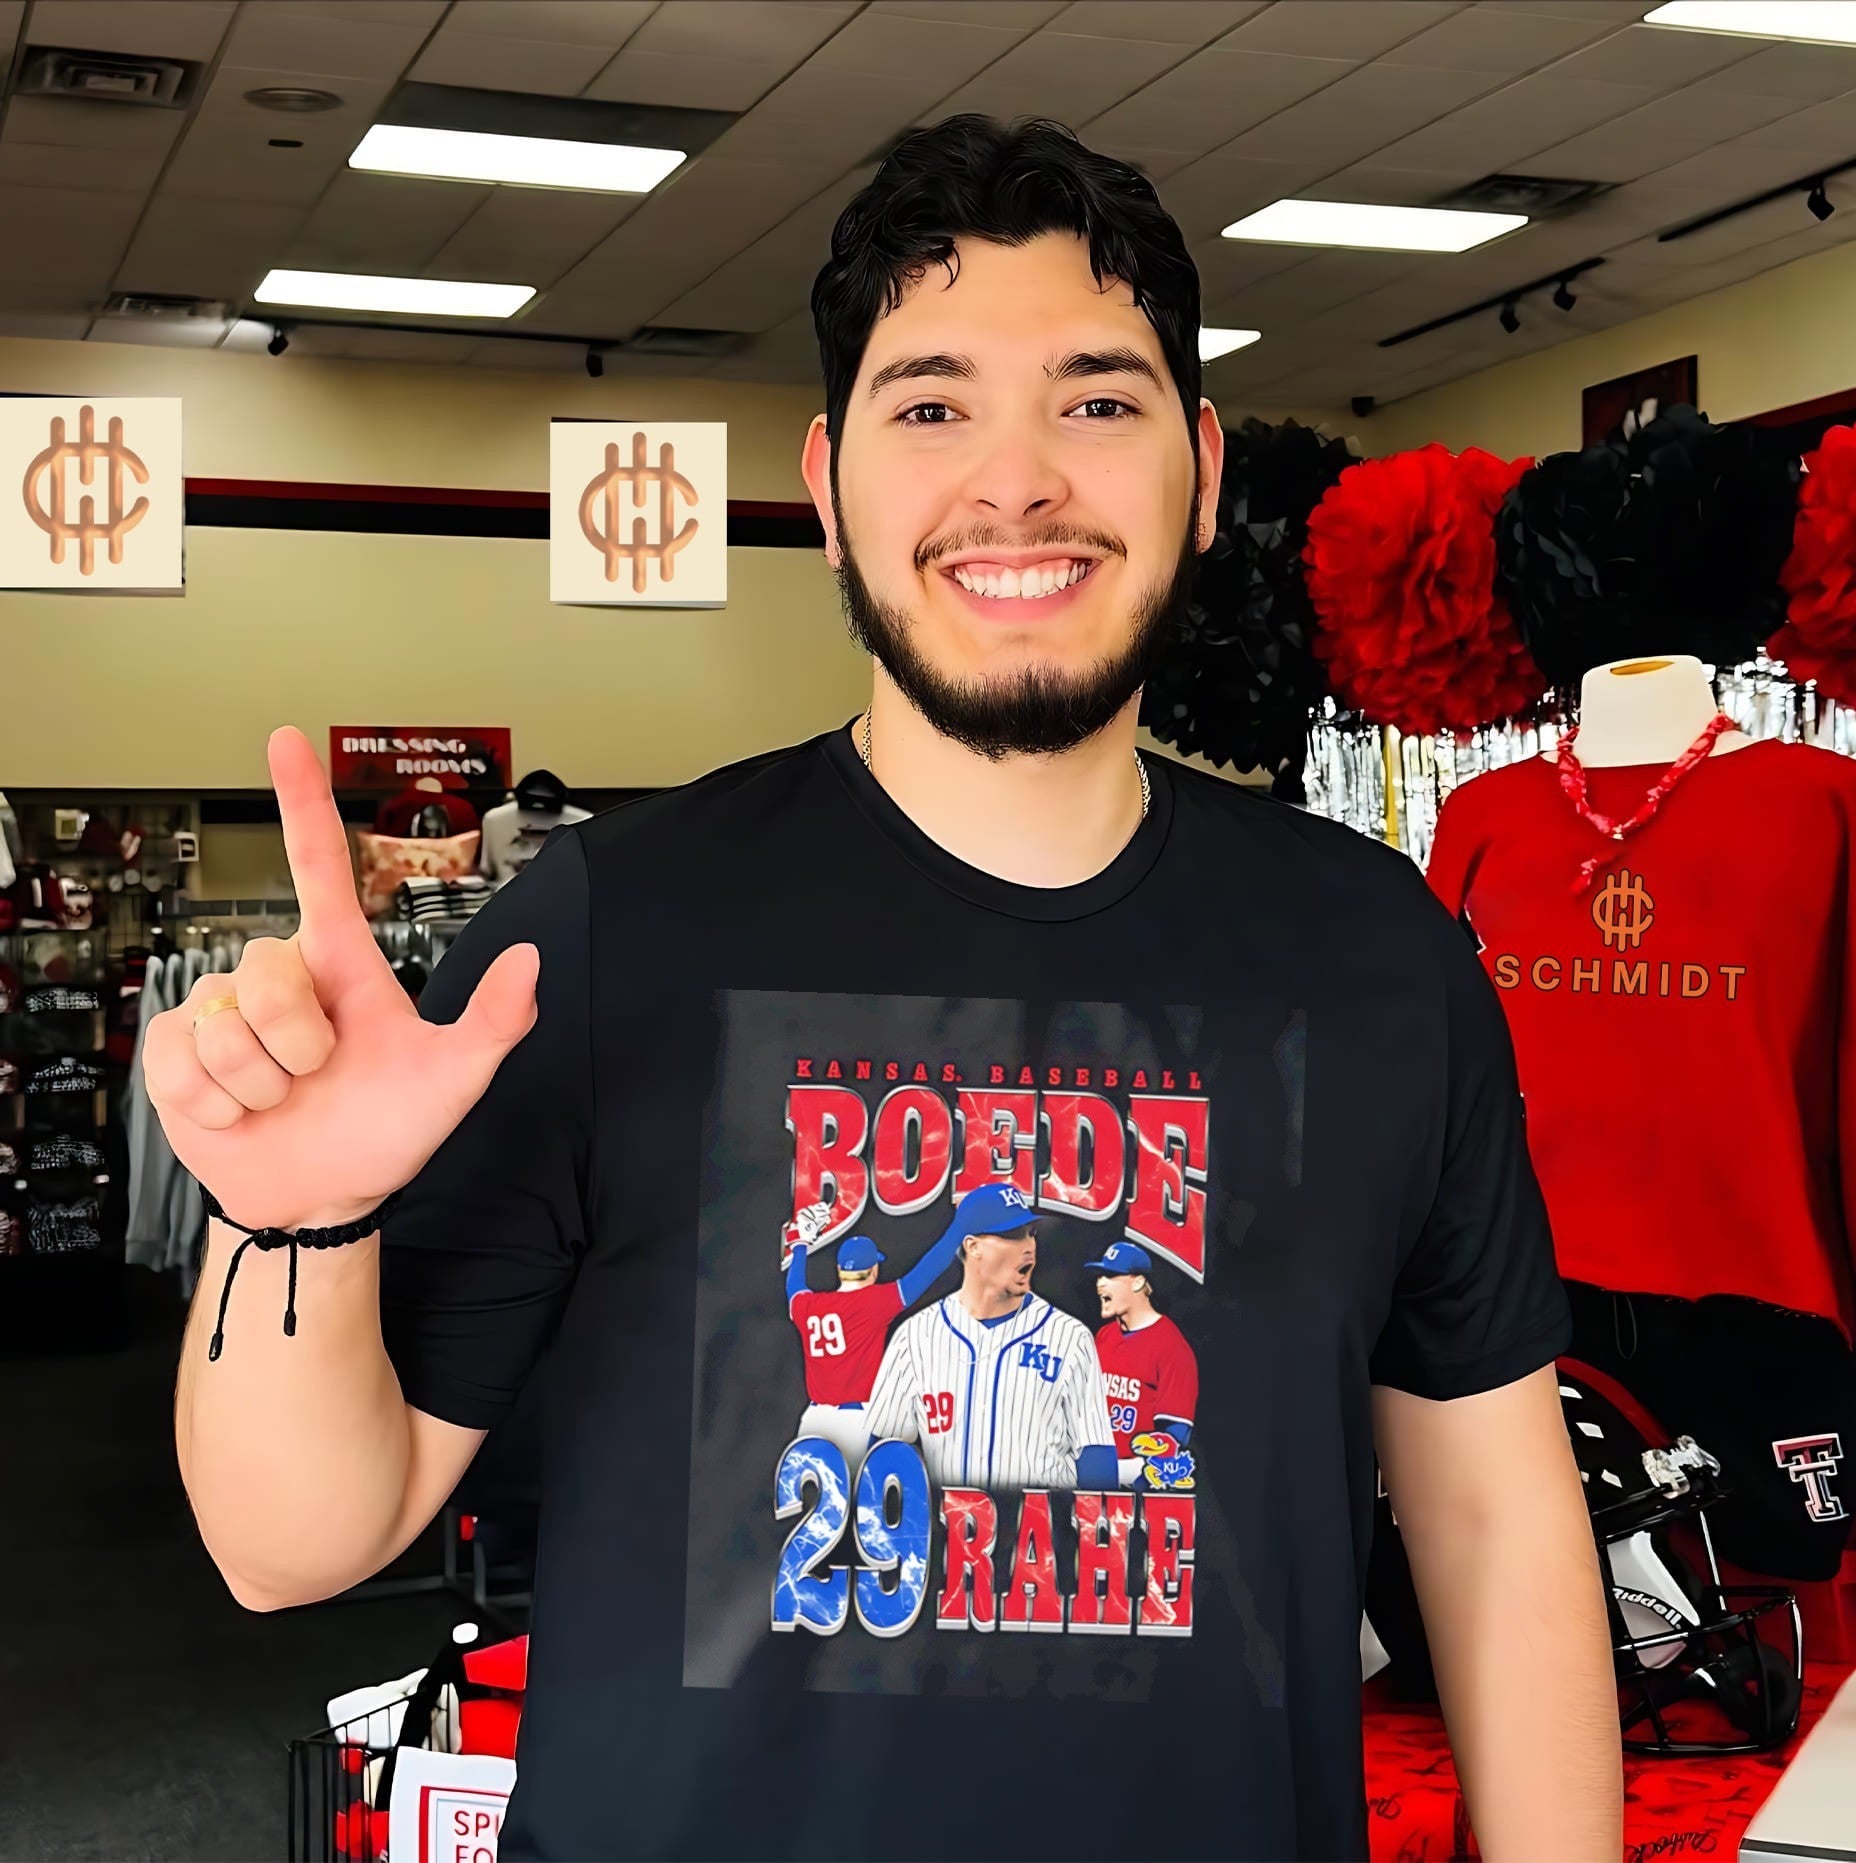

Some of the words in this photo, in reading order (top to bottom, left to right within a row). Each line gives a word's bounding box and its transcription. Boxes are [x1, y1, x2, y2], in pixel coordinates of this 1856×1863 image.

[342, 737, 467, 754] DRESSING
[396, 758, 487, 775] ROOMS
[1494, 954, 1746, 999] SCHMIDT
[990, 1065, 1202, 1090] BASEBALL
[781, 1084, 1210, 1285] BOEDE
[806, 1312, 847, 1357] 29
[1018, 1341, 1063, 1383] KU
[922, 1391, 955, 1434] 29
[1110, 1403, 1138, 1433] 29
[1163, 1461, 1180, 1475] KU
[771, 1435, 933, 1638] 29
[935, 1485, 1198, 1638] RAHE
